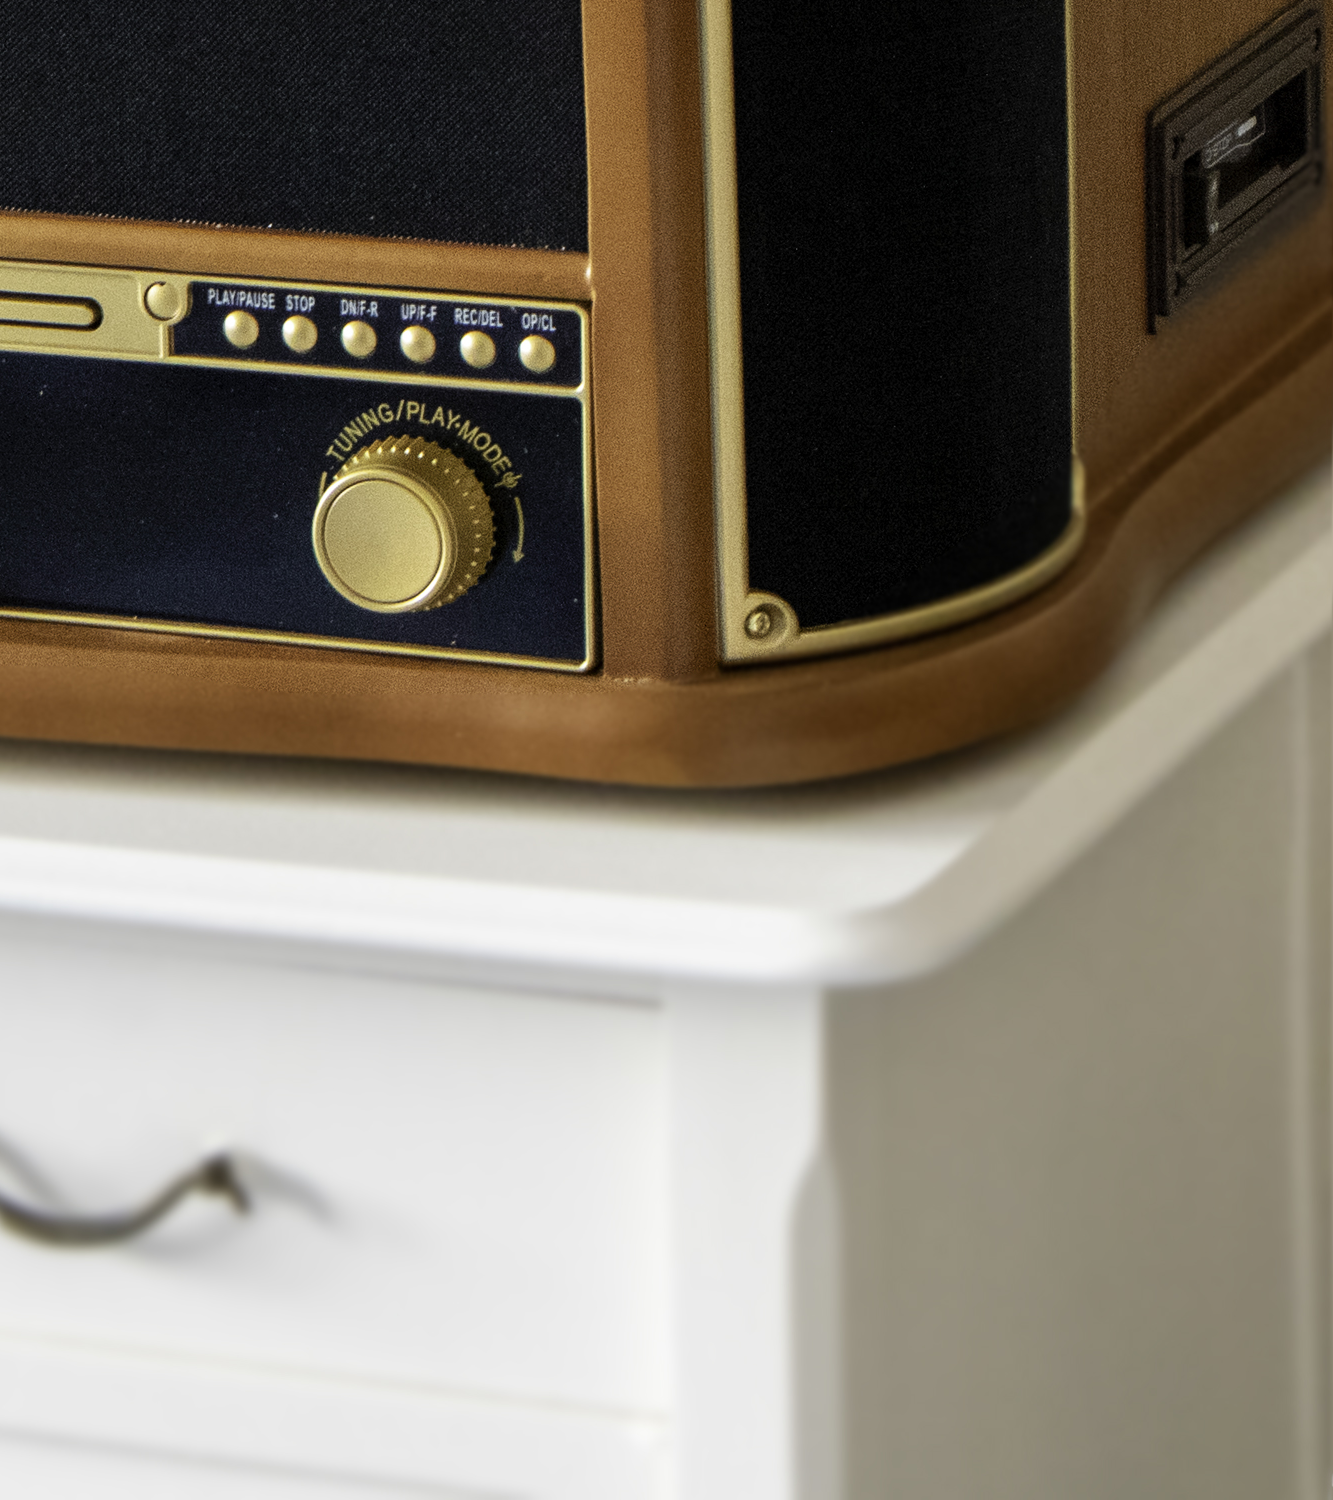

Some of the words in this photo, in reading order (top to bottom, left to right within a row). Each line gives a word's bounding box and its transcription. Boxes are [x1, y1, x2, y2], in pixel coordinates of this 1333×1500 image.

[207, 288, 277, 311] PLAY/PAUSE
[285, 294, 316, 313] STOP
[340, 299, 380, 318] DN/F-R
[454, 307, 504, 329] REC/DEL
[521, 313, 557, 332] OP/CL
